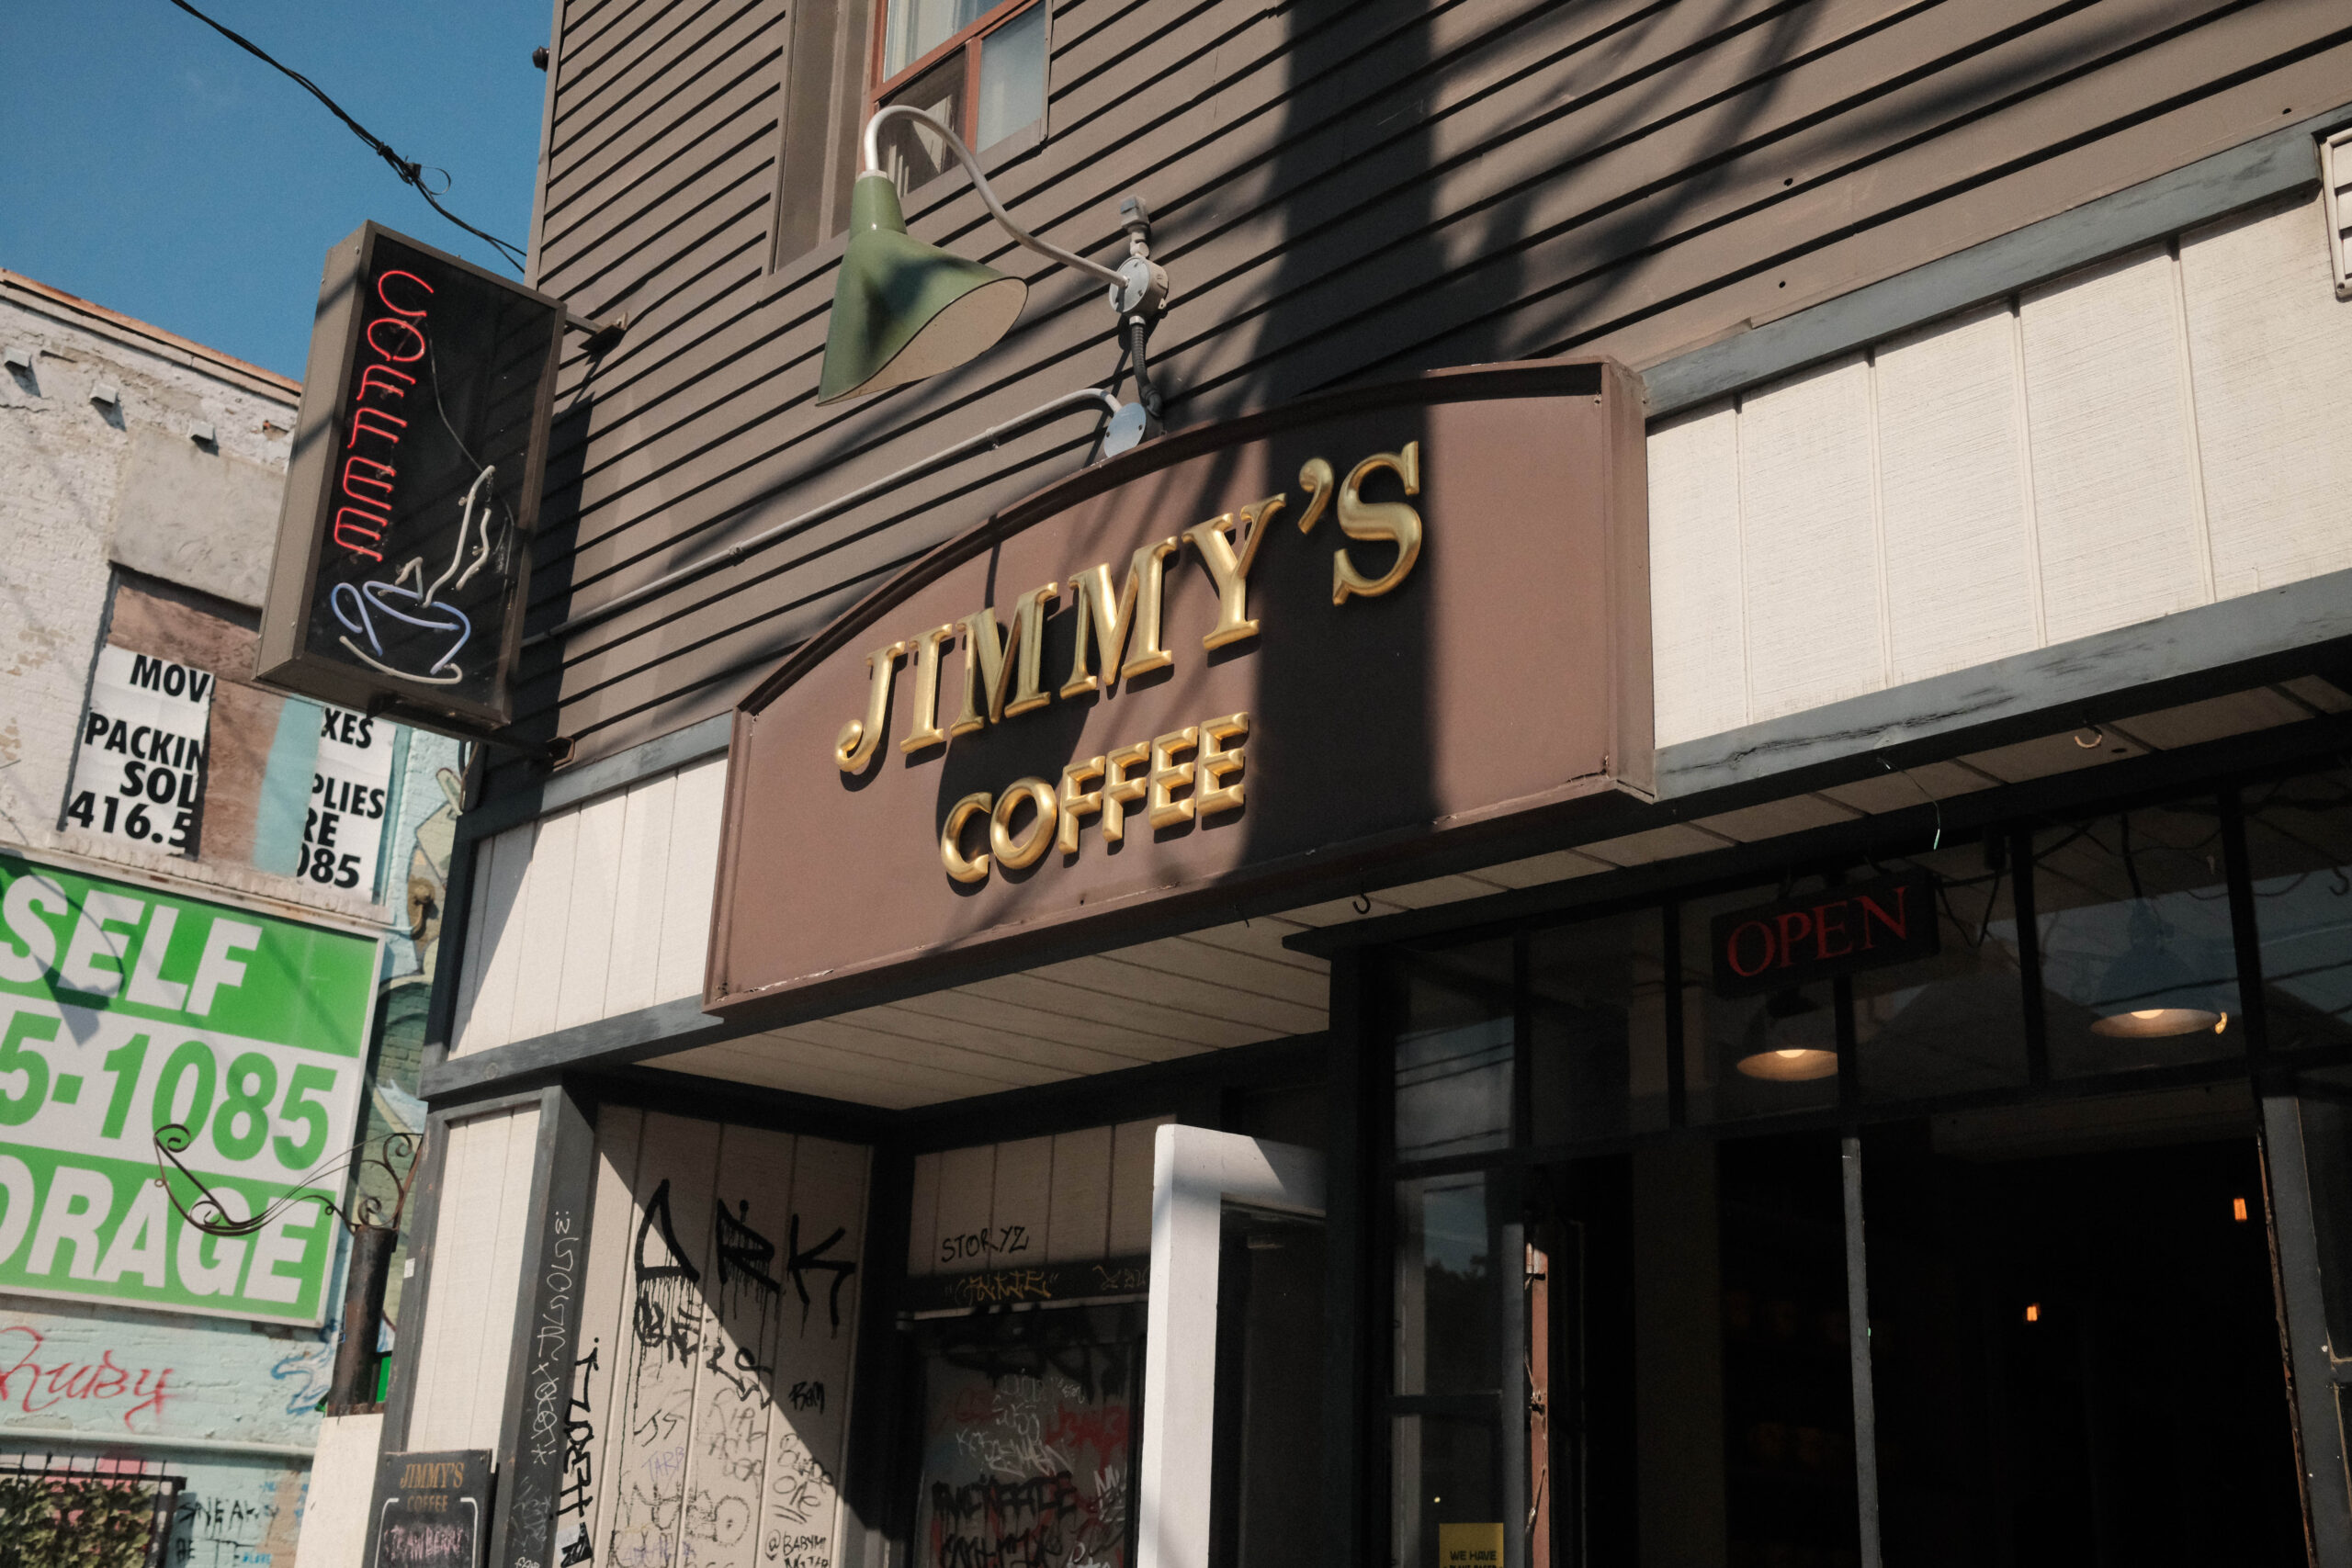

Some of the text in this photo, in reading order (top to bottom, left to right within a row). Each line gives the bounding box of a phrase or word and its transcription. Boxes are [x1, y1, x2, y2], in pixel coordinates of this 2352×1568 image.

[334, 269, 435, 562] COFFEE
[835, 440, 1423, 773] JIMMY'S
[130, 653, 374, 750] MOV XES
[940, 712, 1250, 885] COFFEE
[2, 874, 264, 1017] SELF
[1727, 886, 1909, 976] OPEN
[0, 1010, 338, 1171] 5-1085
[399, 1461, 465, 1490] JIMMY'S
[406, 1495, 449, 1513] COFFEE
[1449, 1550, 1497, 1561] WE HAVE
